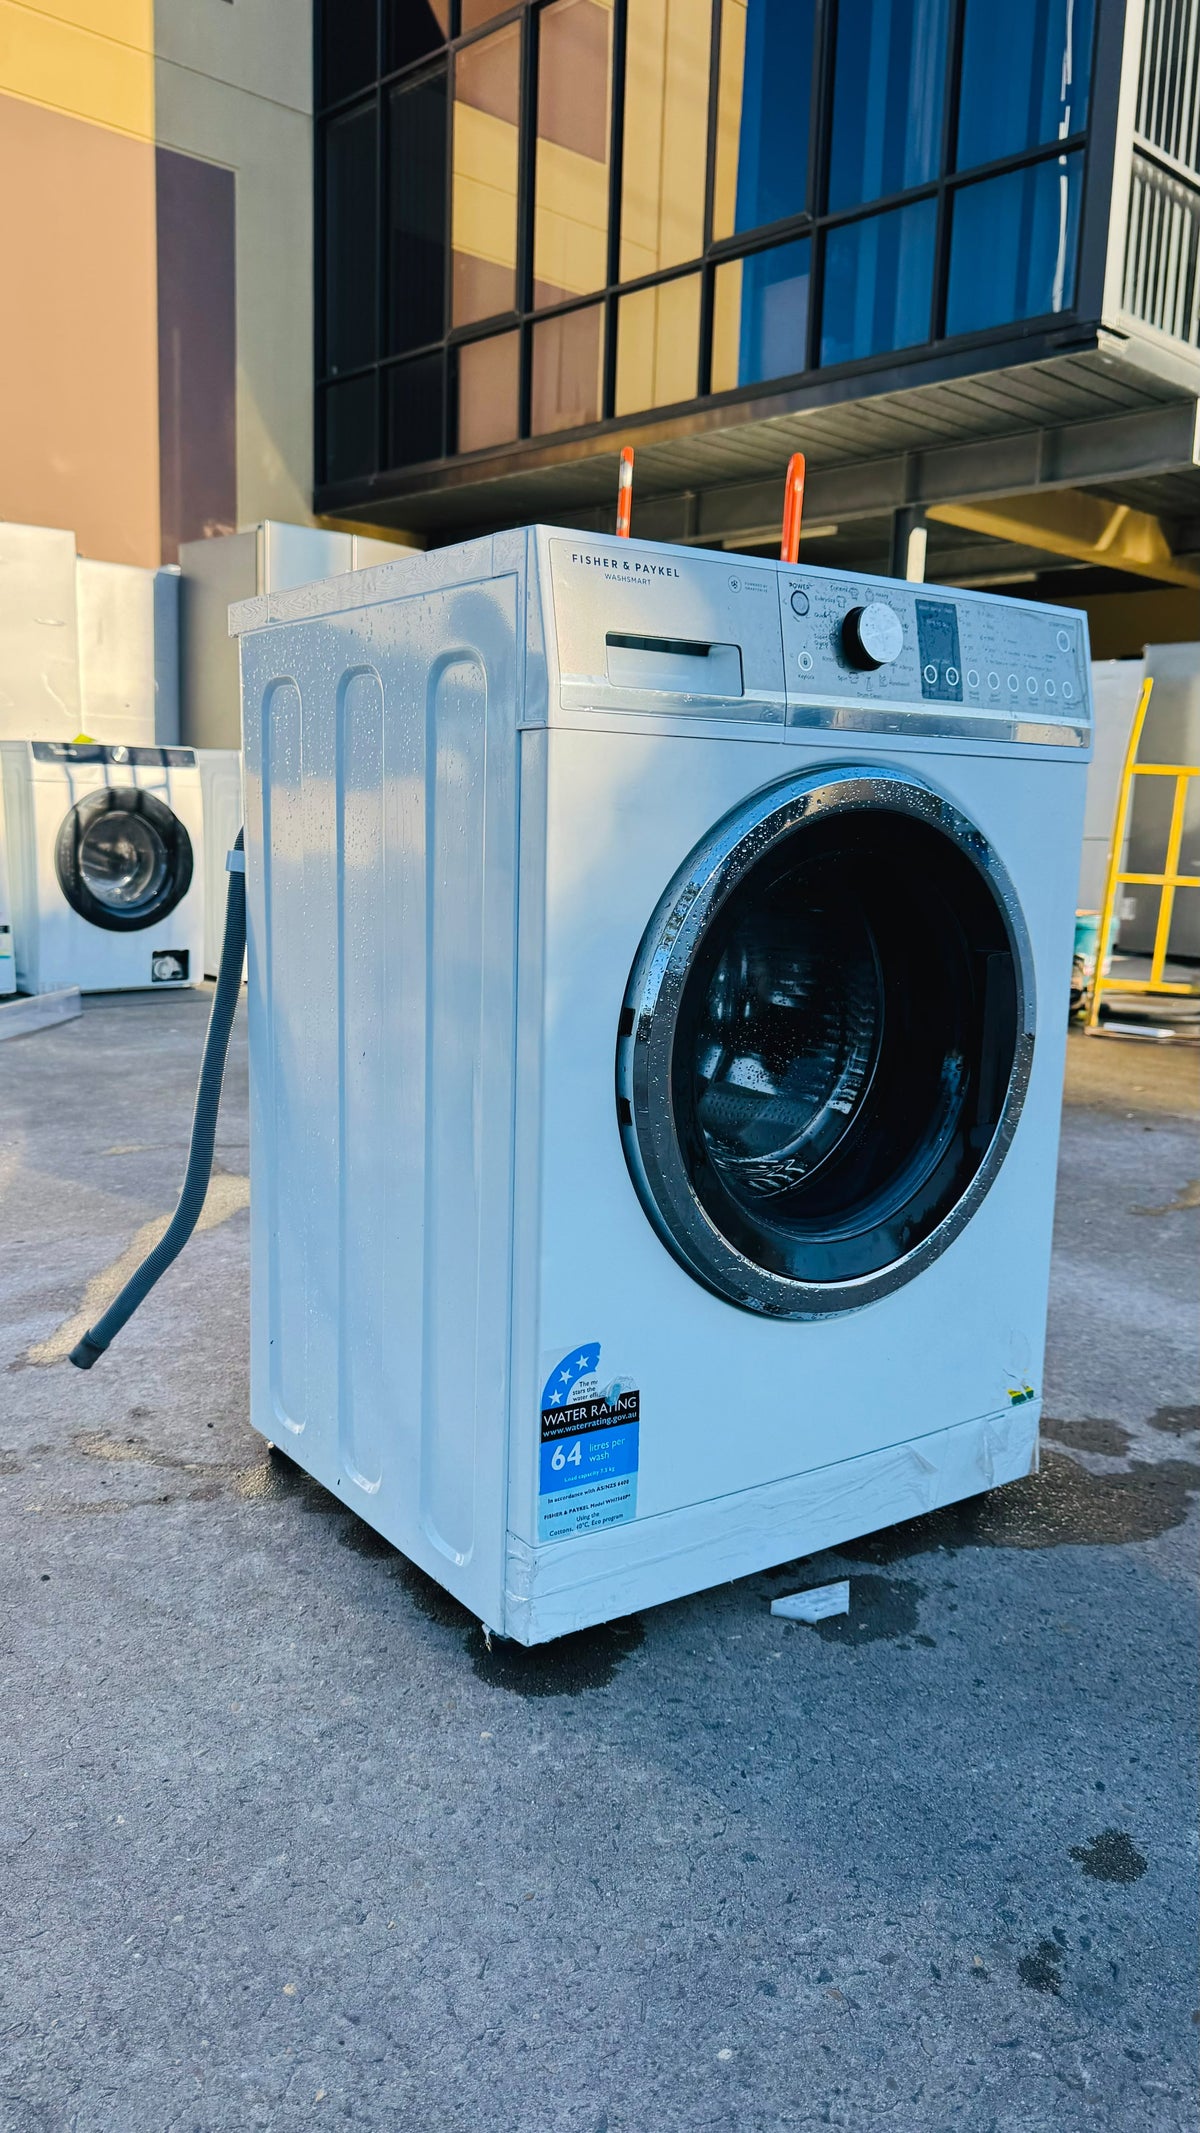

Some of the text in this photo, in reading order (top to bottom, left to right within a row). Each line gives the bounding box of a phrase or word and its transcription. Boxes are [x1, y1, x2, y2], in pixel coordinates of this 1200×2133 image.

[572, 554, 680, 577] FISHER & PAYKEL
[604, 573, 651, 585] WASHSMART
[543, 1407, 587, 1426] WATER
[543, 1412, 637, 1437] www.waterrating.gov.au
[551, 1438, 625, 1471] 64 litres per
[589, 1451, 610, 1462] wash
[554, 1492, 583, 1503] accordance
[576, 1515, 591, 1523] Using
[602, 1514, 623, 1523] program
